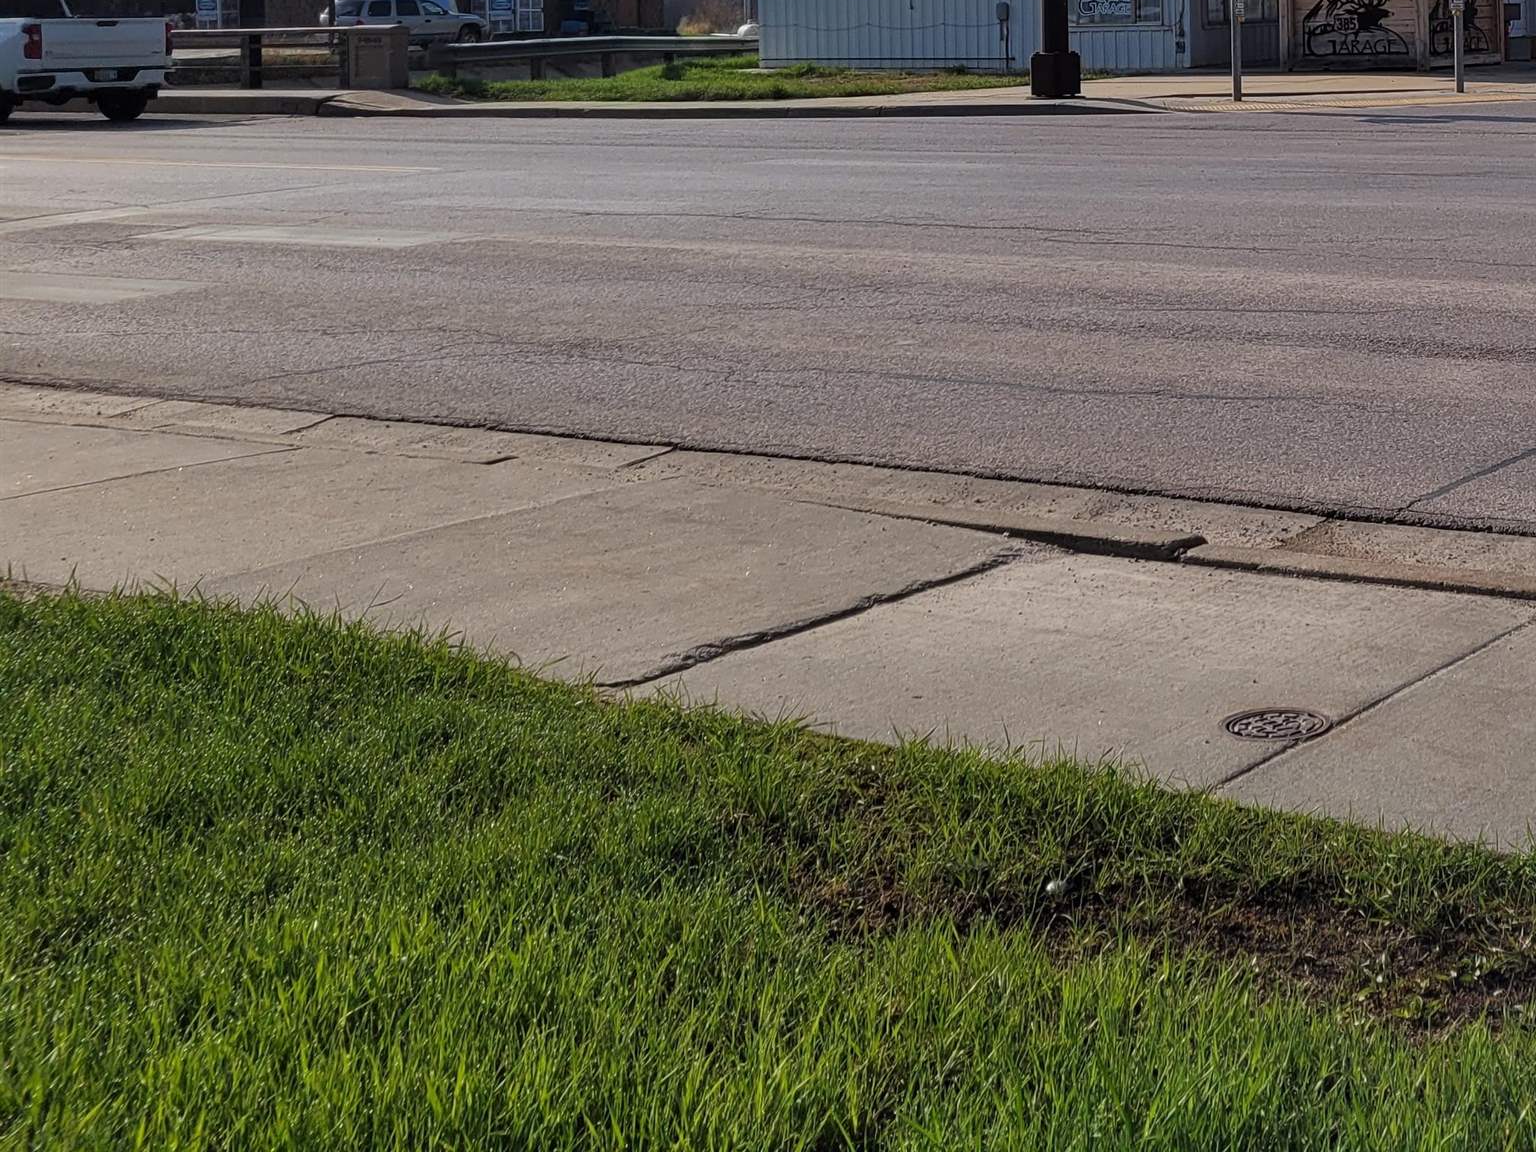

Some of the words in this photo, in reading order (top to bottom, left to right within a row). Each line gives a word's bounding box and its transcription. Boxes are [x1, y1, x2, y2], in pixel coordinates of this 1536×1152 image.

[1079, 0, 1131, 16] GARAGE
[1336, 18, 1356, 30] 385
[1307, 30, 1398, 56] GARAGE
